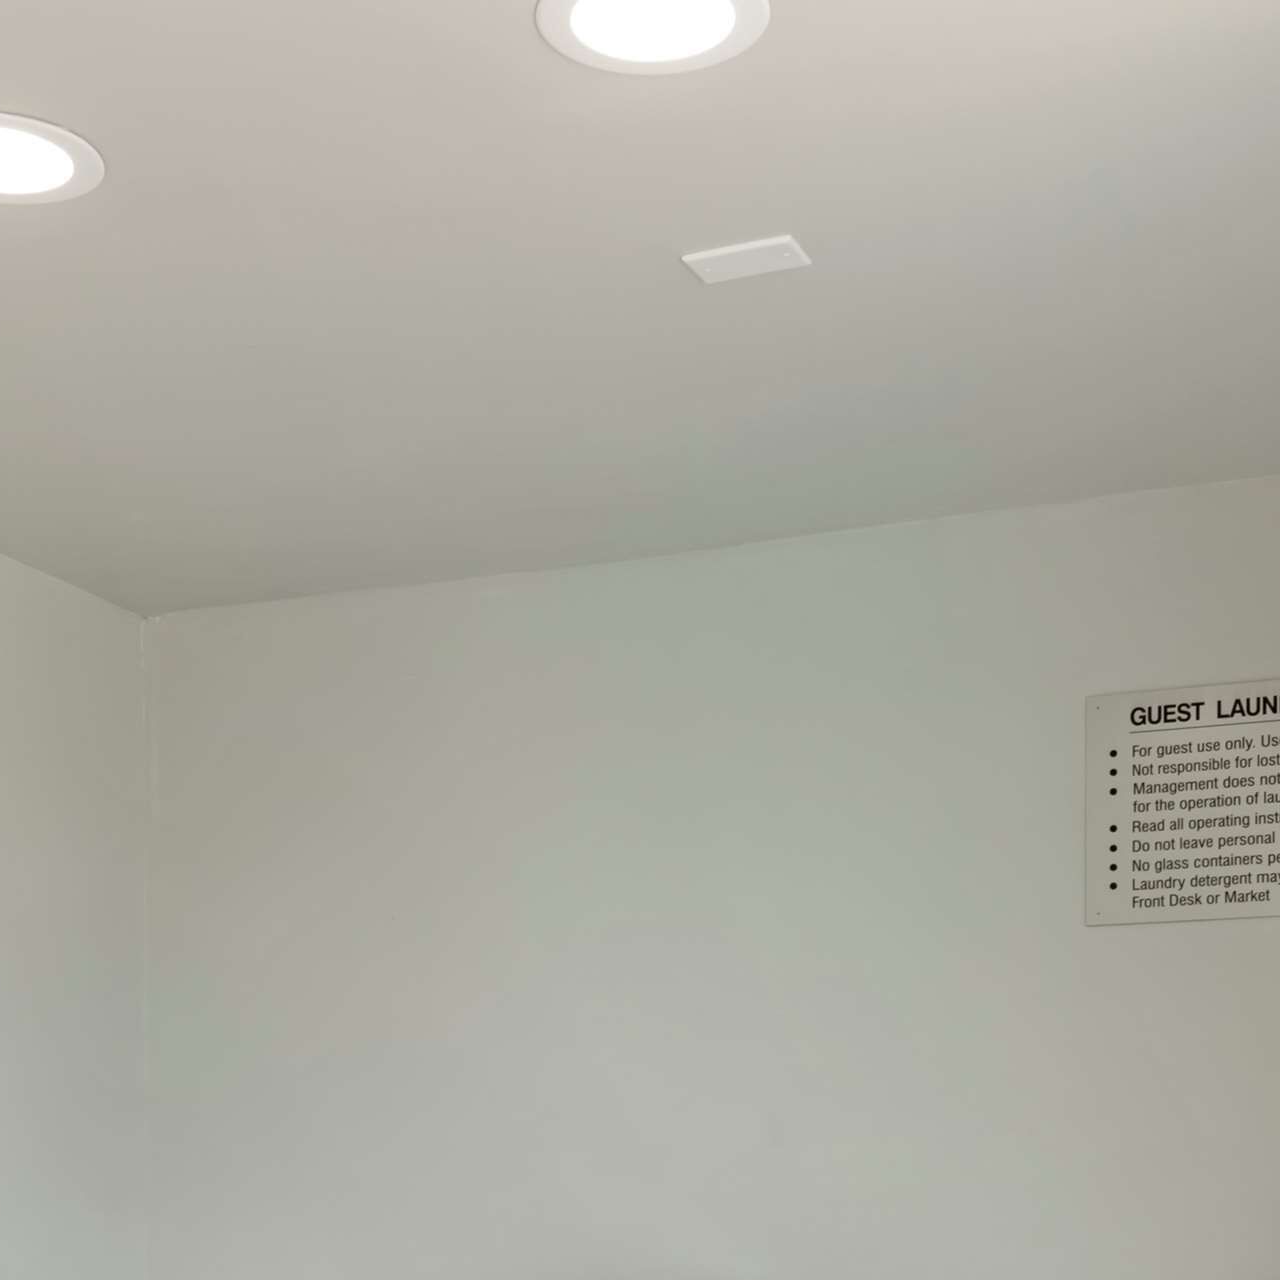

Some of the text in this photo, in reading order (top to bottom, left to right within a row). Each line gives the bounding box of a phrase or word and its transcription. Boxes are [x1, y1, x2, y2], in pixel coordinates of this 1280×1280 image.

[1129, 700, 1206, 727] GUEST
[1131, 744, 1153, 758] For
[1156, 741, 1193, 759] guest
[1196, 740, 1221, 753] use
[1224, 736, 1256, 752] only.
[1131, 763, 1154, 777] Not
[1157, 757, 1231, 776] responsible
[1234, 755, 1253, 769] for
[1256, 753, 1280, 768] lost
[1133, 777, 1219, 796] Management
[1222, 775, 1256, 789] does
[1132, 799, 1152, 813] for
[1154, 799, 1176, 812] the
[1178, 794, 1242, 812] operation
[1245, 791, 1259, 806] of
[1131, 818, 1166, 833] Read
[1169, 817, 1184, 832] all
[1187, 814, 1251, 832] operating
[1131, 839, 1151, 853] Do
[1154, 838, 1176, 851] not
[1179, 837, 1214, 850] leave
[1217, 831, 1276, 850] personal
[1131, 859, 1151, 873] No
[1154, 857, 1190, 874] glass
[1193, 854, 1264, 869] containers
[1132, 876, 1186, 892] Laundry
[1189, 871, 1252, 888] detergent
[1131, 889, 1271, 909] Front Desk or Market
